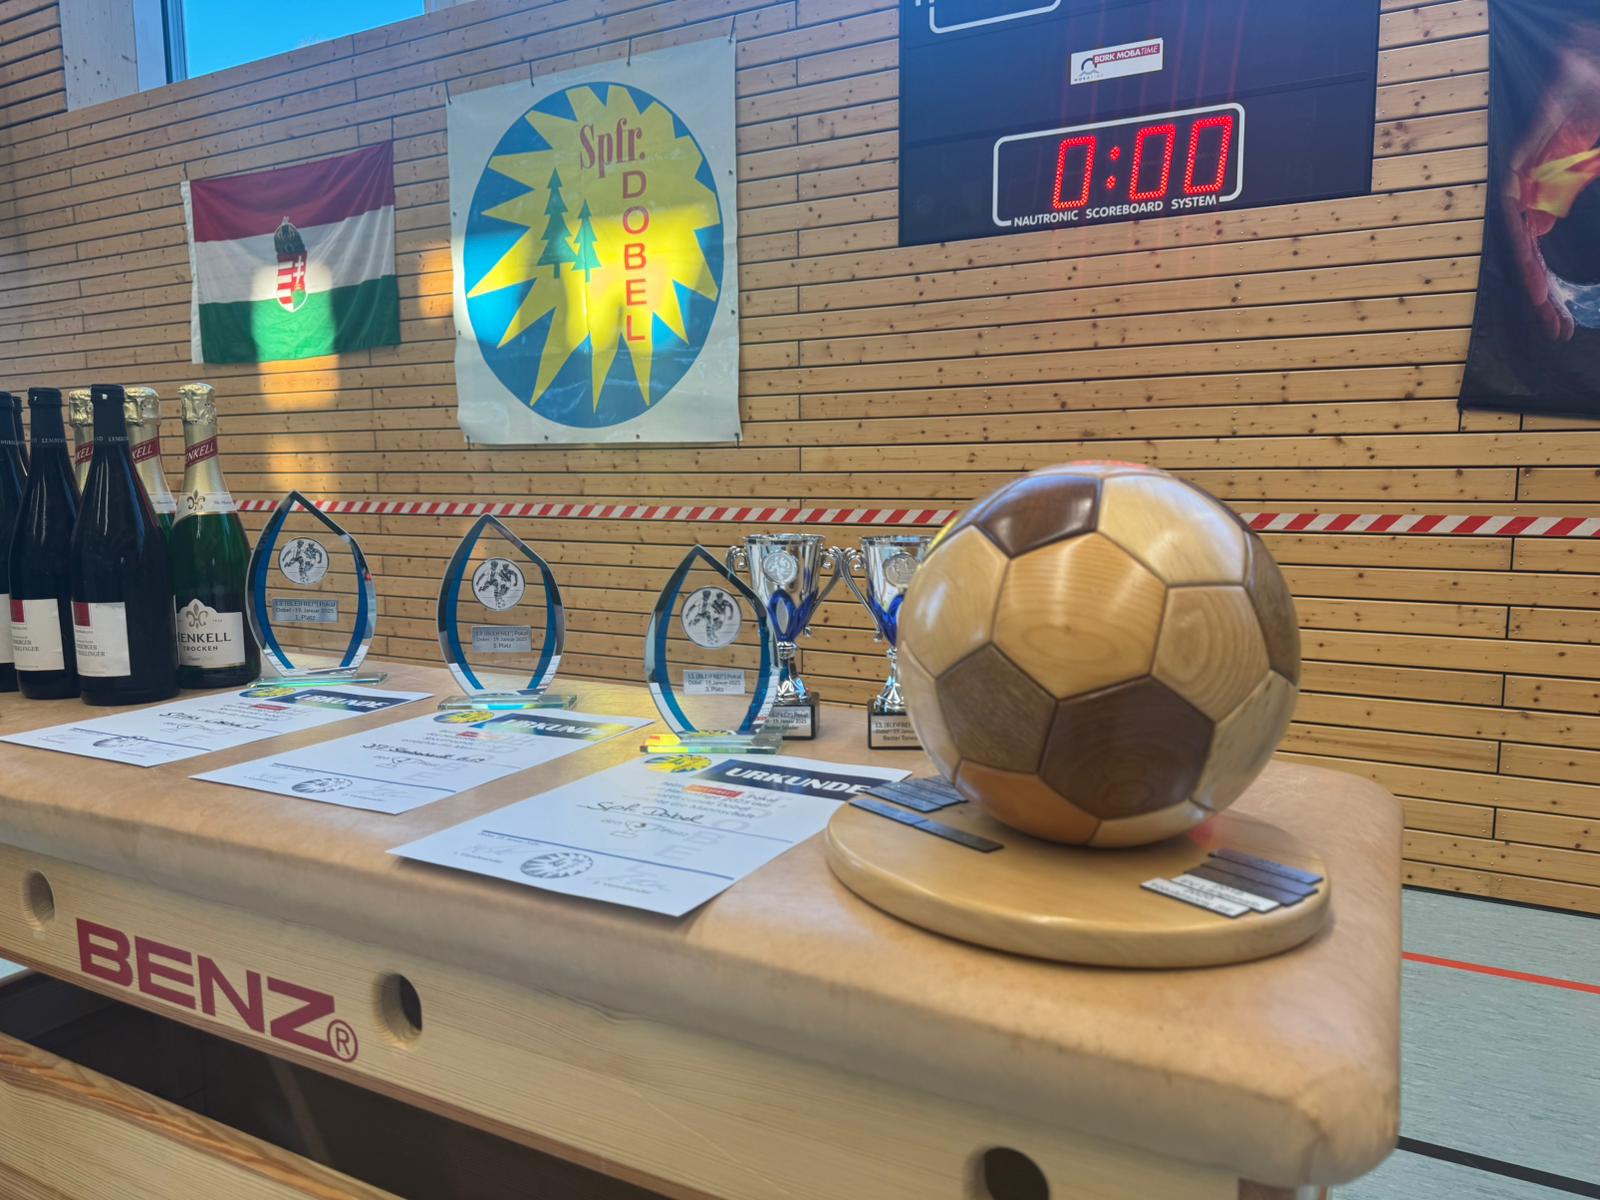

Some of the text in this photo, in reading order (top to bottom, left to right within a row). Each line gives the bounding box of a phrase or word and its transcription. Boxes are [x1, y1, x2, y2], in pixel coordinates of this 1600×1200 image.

[1052, 115, 1233, 209] 0:00
[1013, 194, 1217, 228] NAUTRONIC SCOREBOARD SYSTEM
[622, 169, 650, 342] DOBEL
[183, 645, 219, 653] TROCKEN
[725, 766, 873, 796] URKUNDE
